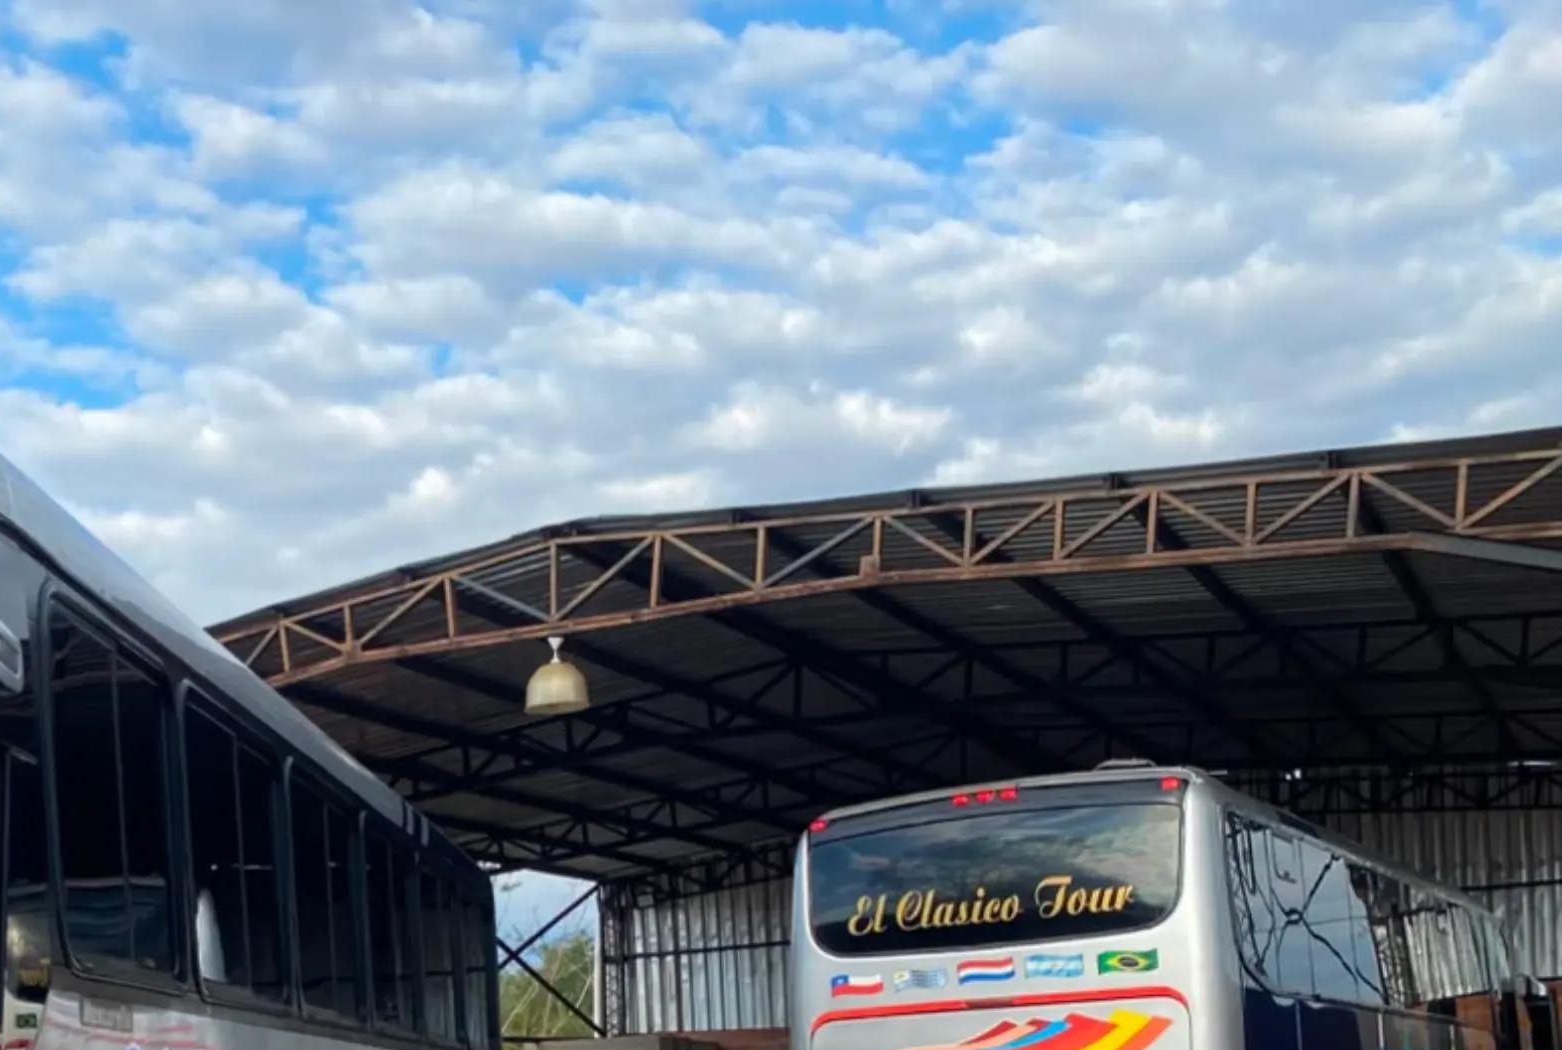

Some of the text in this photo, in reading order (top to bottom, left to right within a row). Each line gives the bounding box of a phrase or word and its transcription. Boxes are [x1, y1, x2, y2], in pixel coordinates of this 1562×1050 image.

[848, 875, 1135, 936] El Clasico Tour
